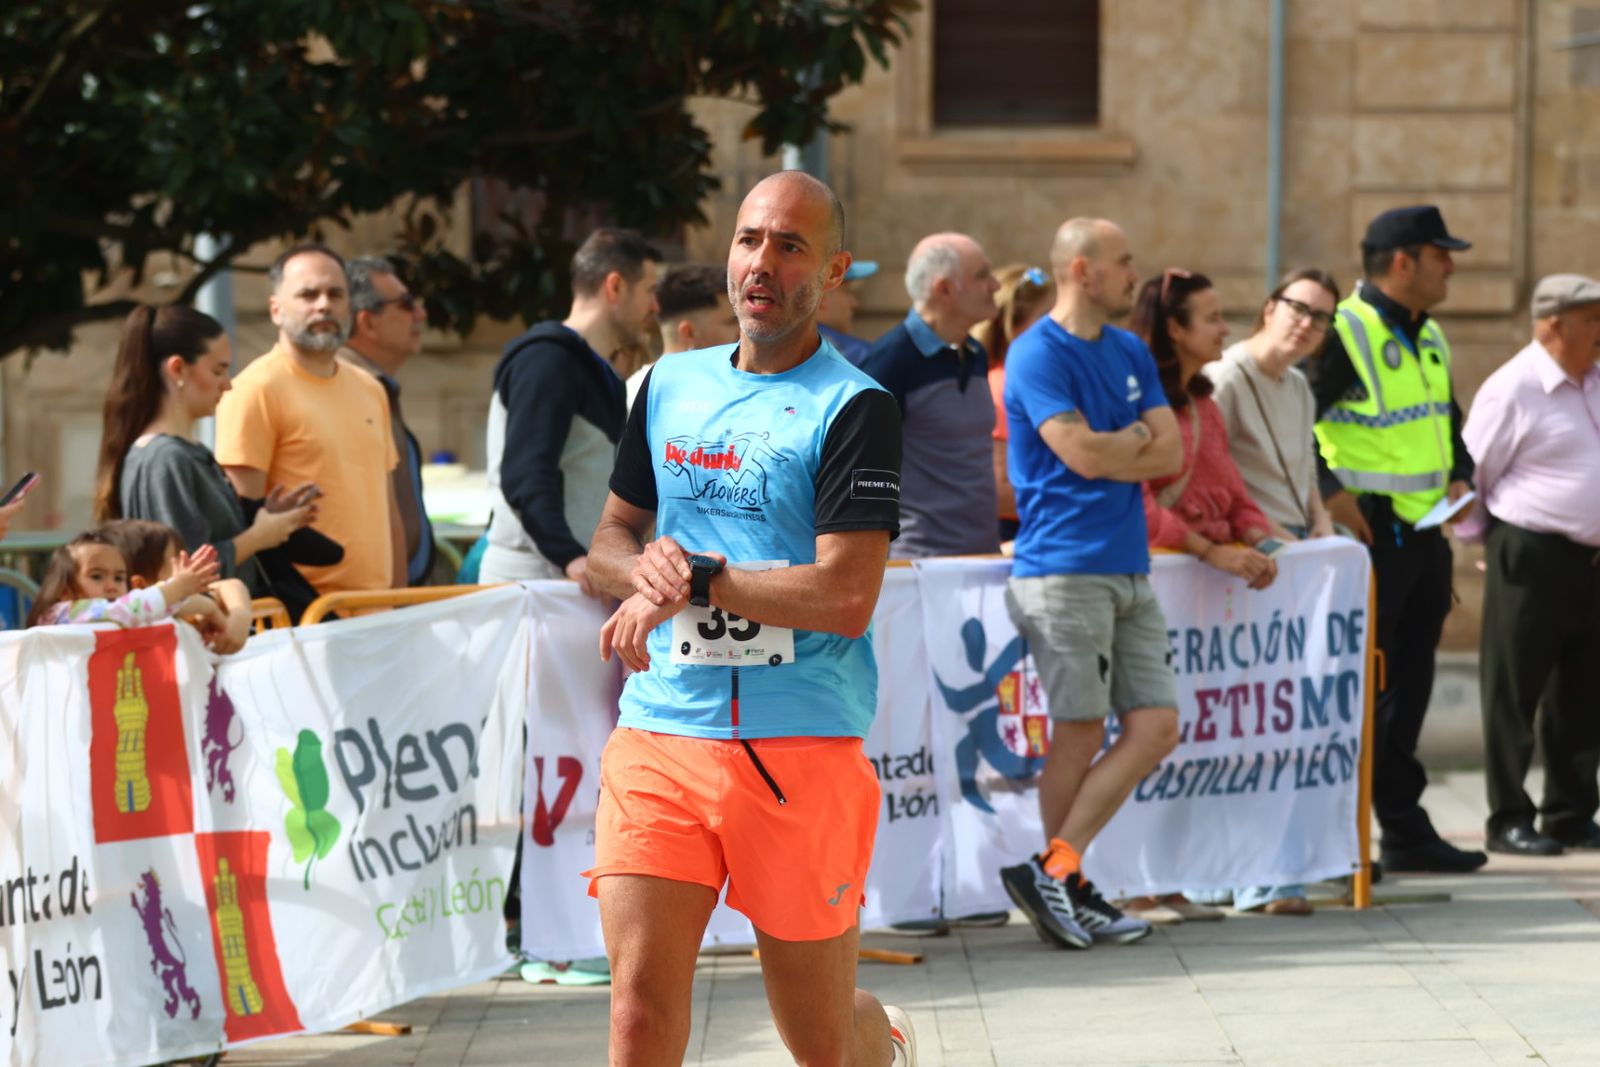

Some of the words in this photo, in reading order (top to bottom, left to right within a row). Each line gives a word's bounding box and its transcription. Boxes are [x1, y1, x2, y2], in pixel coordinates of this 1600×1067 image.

[701, 478, 757, 506] FLOWERS
[1167, 610, 1306, 674] ERACIÓN
[1327, 609, 1364, 657] DE
[1178, 669, 1359, 744] ETISMO
[334, 717, 482, 817] Plen
[1134, 752, 1264, 802] CASTILLA
[1268, 748, 1290, 791] Y
[1294, 732, 1358, 790] LEÓN
[440, 867, 504, 918] León
